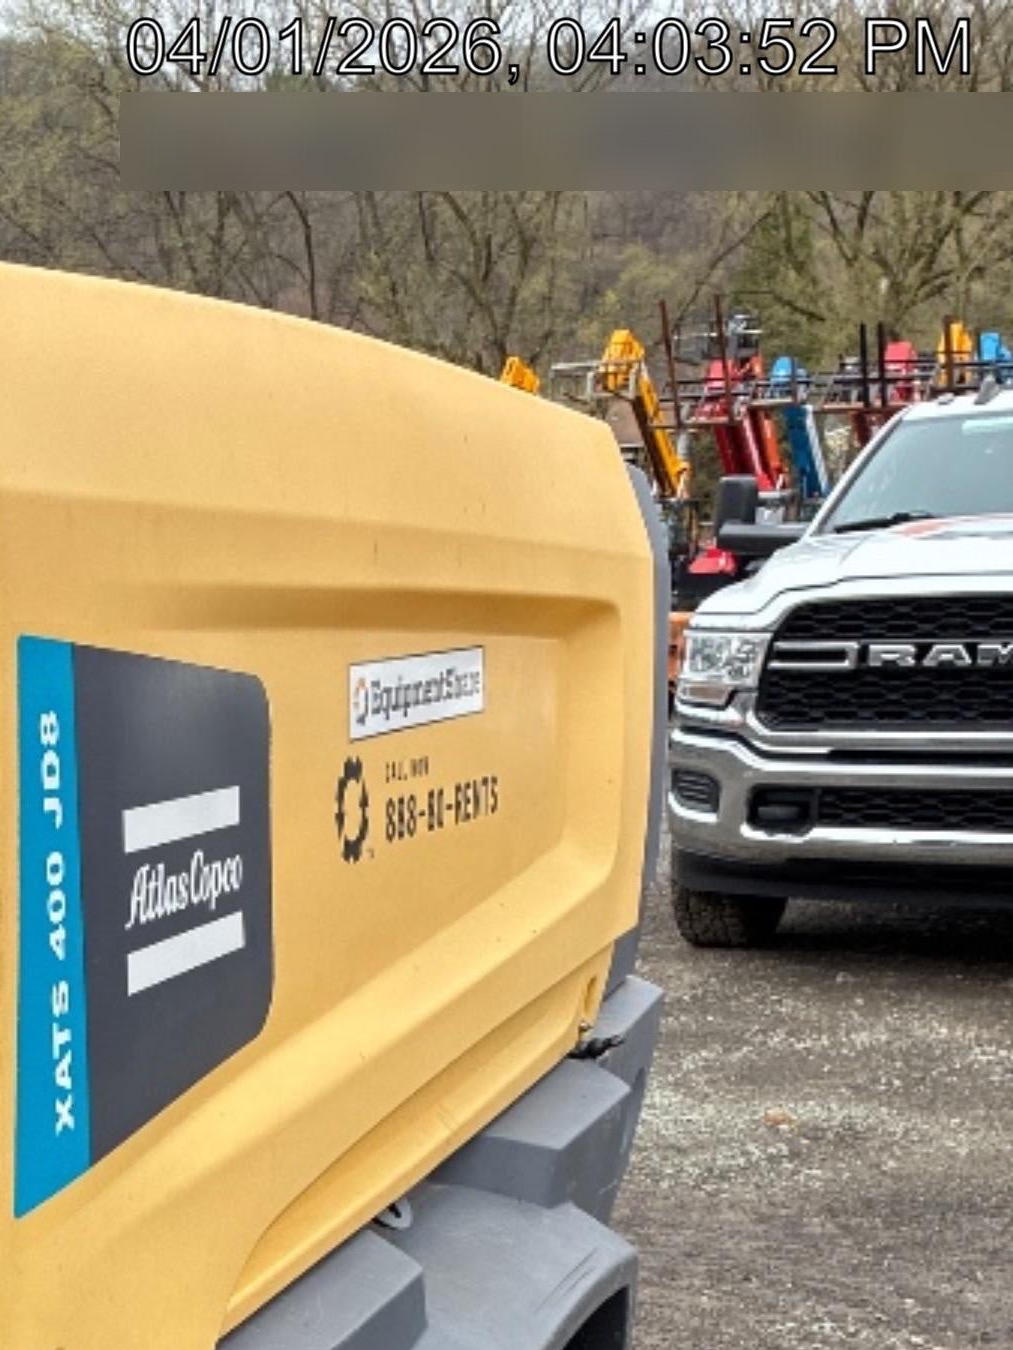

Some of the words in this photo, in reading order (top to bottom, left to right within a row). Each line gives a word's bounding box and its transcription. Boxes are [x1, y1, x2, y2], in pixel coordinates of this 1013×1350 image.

[39, 711, 62, 828] JD8
[46, 851, 66, 960] 400
[125, 863, 189, 929] Atlas
[191, 849, 243, 910] Copco
[52, 980, 76, 1135] XATS
